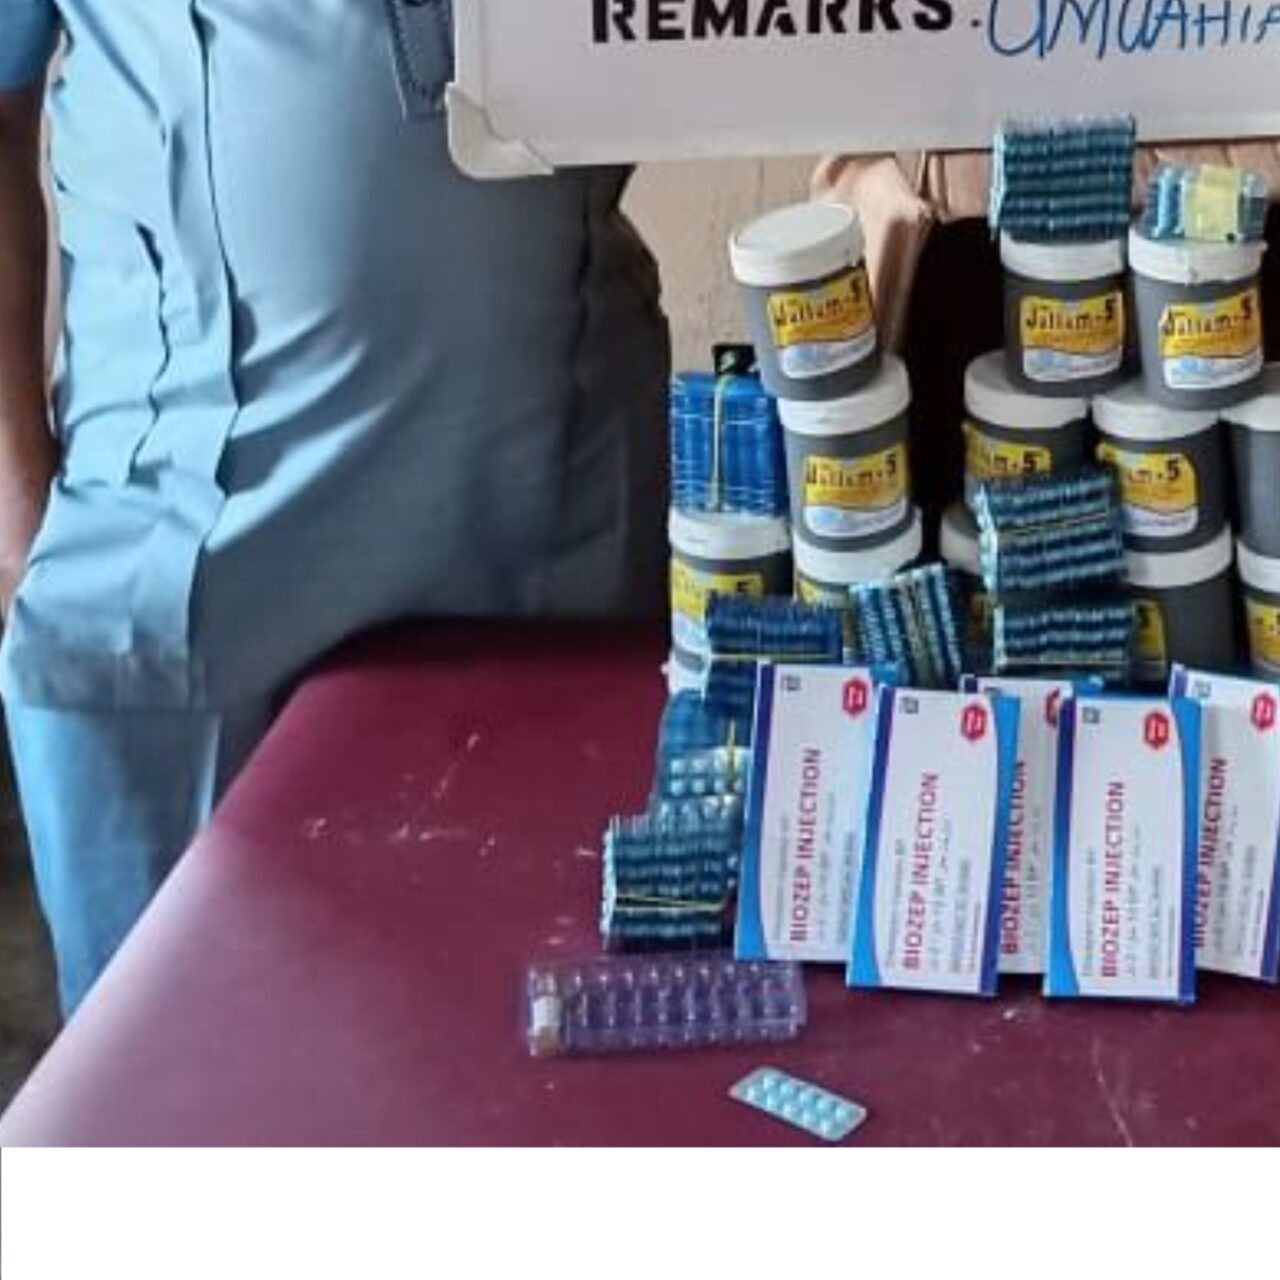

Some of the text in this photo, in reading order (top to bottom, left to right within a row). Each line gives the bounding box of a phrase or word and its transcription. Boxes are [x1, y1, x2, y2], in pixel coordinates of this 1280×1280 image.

[796, 748, 821, 858] INJECTION
[911, 773, 939, 885] INJECTION
[1101, 782, 1124, 977] BIOZEP INJECTION
